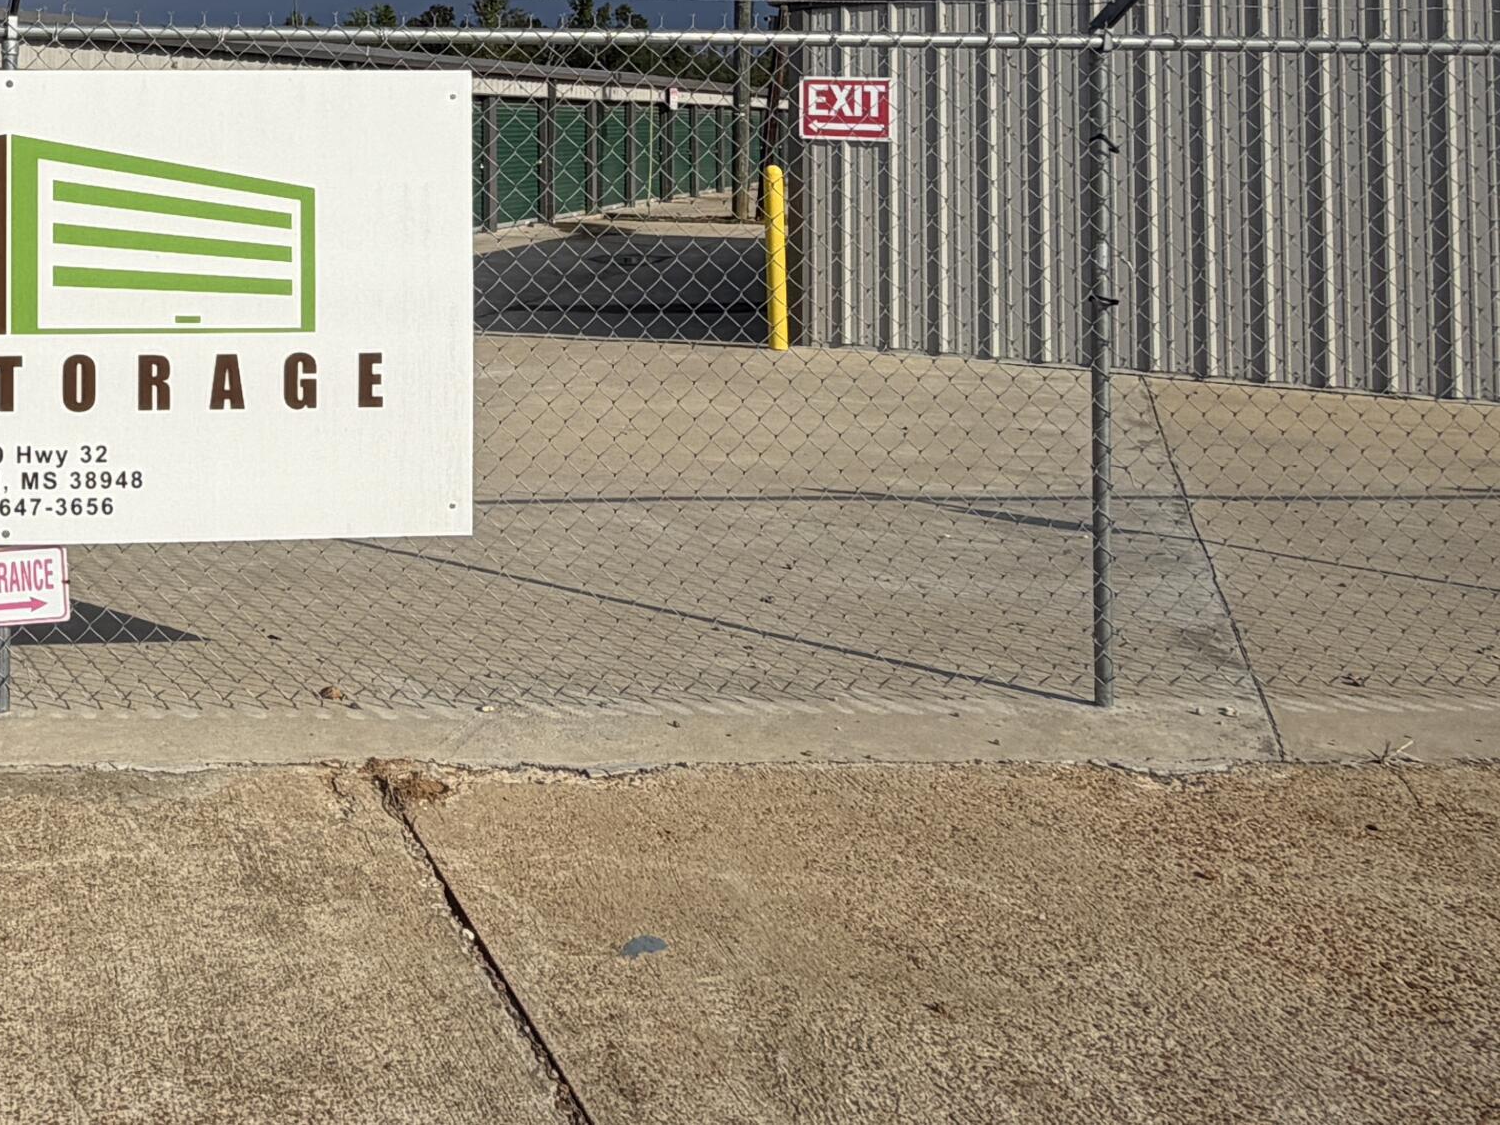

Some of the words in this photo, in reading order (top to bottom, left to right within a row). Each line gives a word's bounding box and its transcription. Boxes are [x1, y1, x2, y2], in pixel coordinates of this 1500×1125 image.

[808, 84, 886, 118] EXIT
[16, 446, 69, 468] Hwy
[80, 445, 108, 464] 32
[21, 472, 58, 490] MS
[69, 471, 144, 490] 38948
[0, 498, 115, 517] 647-3656
